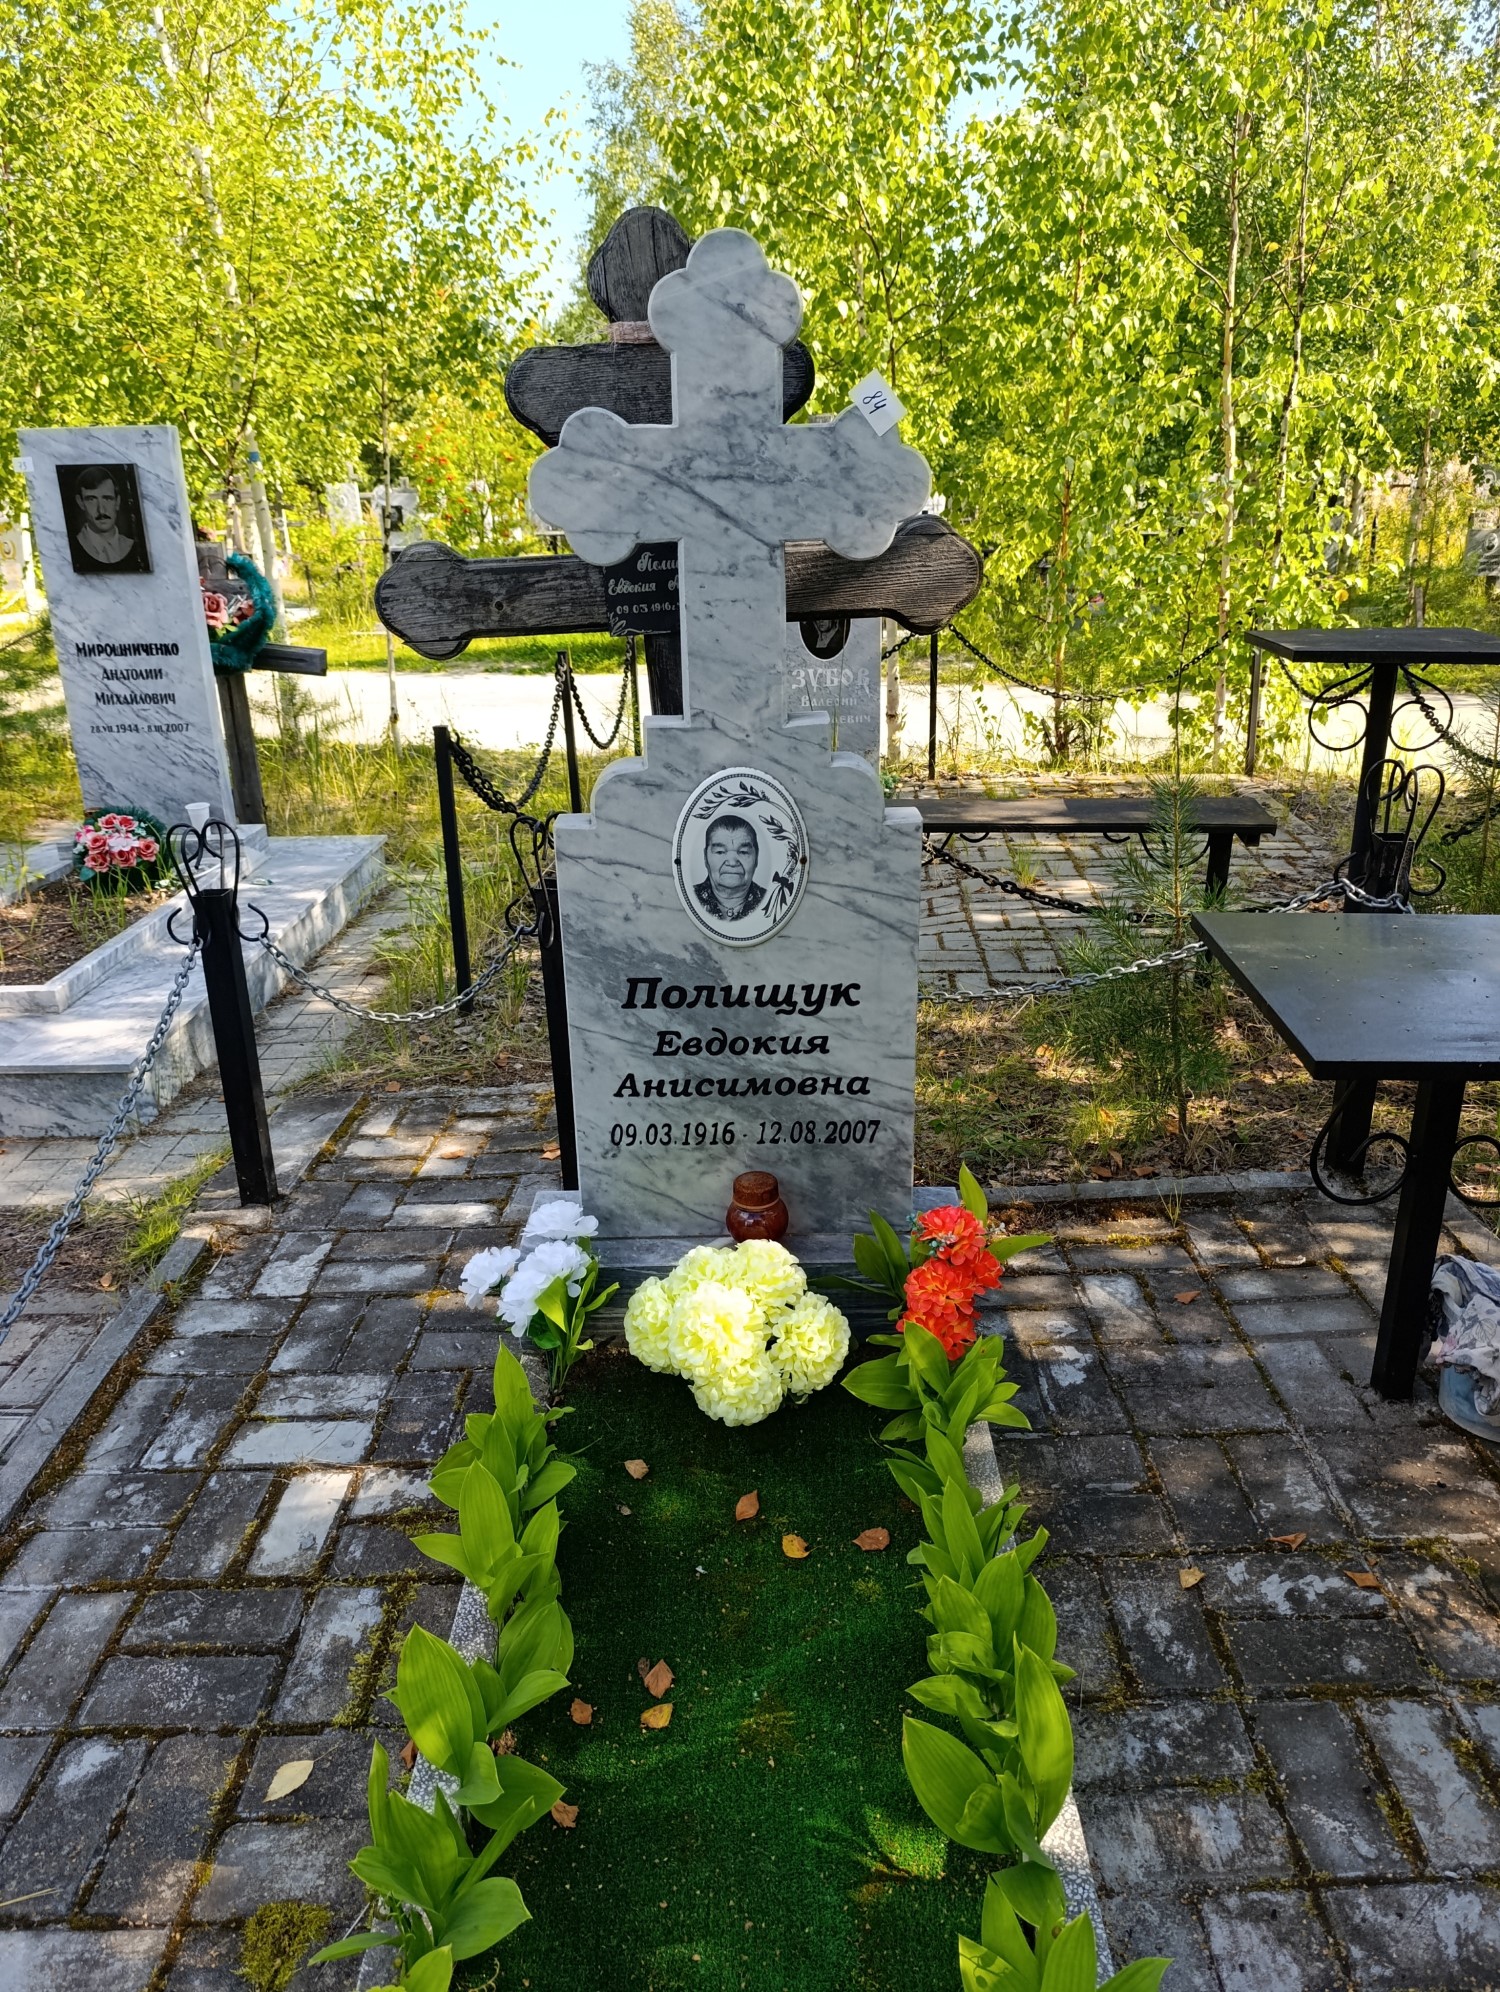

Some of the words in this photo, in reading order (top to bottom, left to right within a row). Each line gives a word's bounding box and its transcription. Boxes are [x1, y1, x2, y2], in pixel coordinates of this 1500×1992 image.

[862, 390, 887, 414] 84
[636, 551, 679, 572] Поли
[621, 977, 861, 1016] Полищук
[653, 1027, 830, 1056] Евдокия
[613, 1073, 871, 1098] Анисимовна
[610, 1121, 735, 1146] 09.03.1916
[756, 1120, 881, 1145] 12.08.2007
